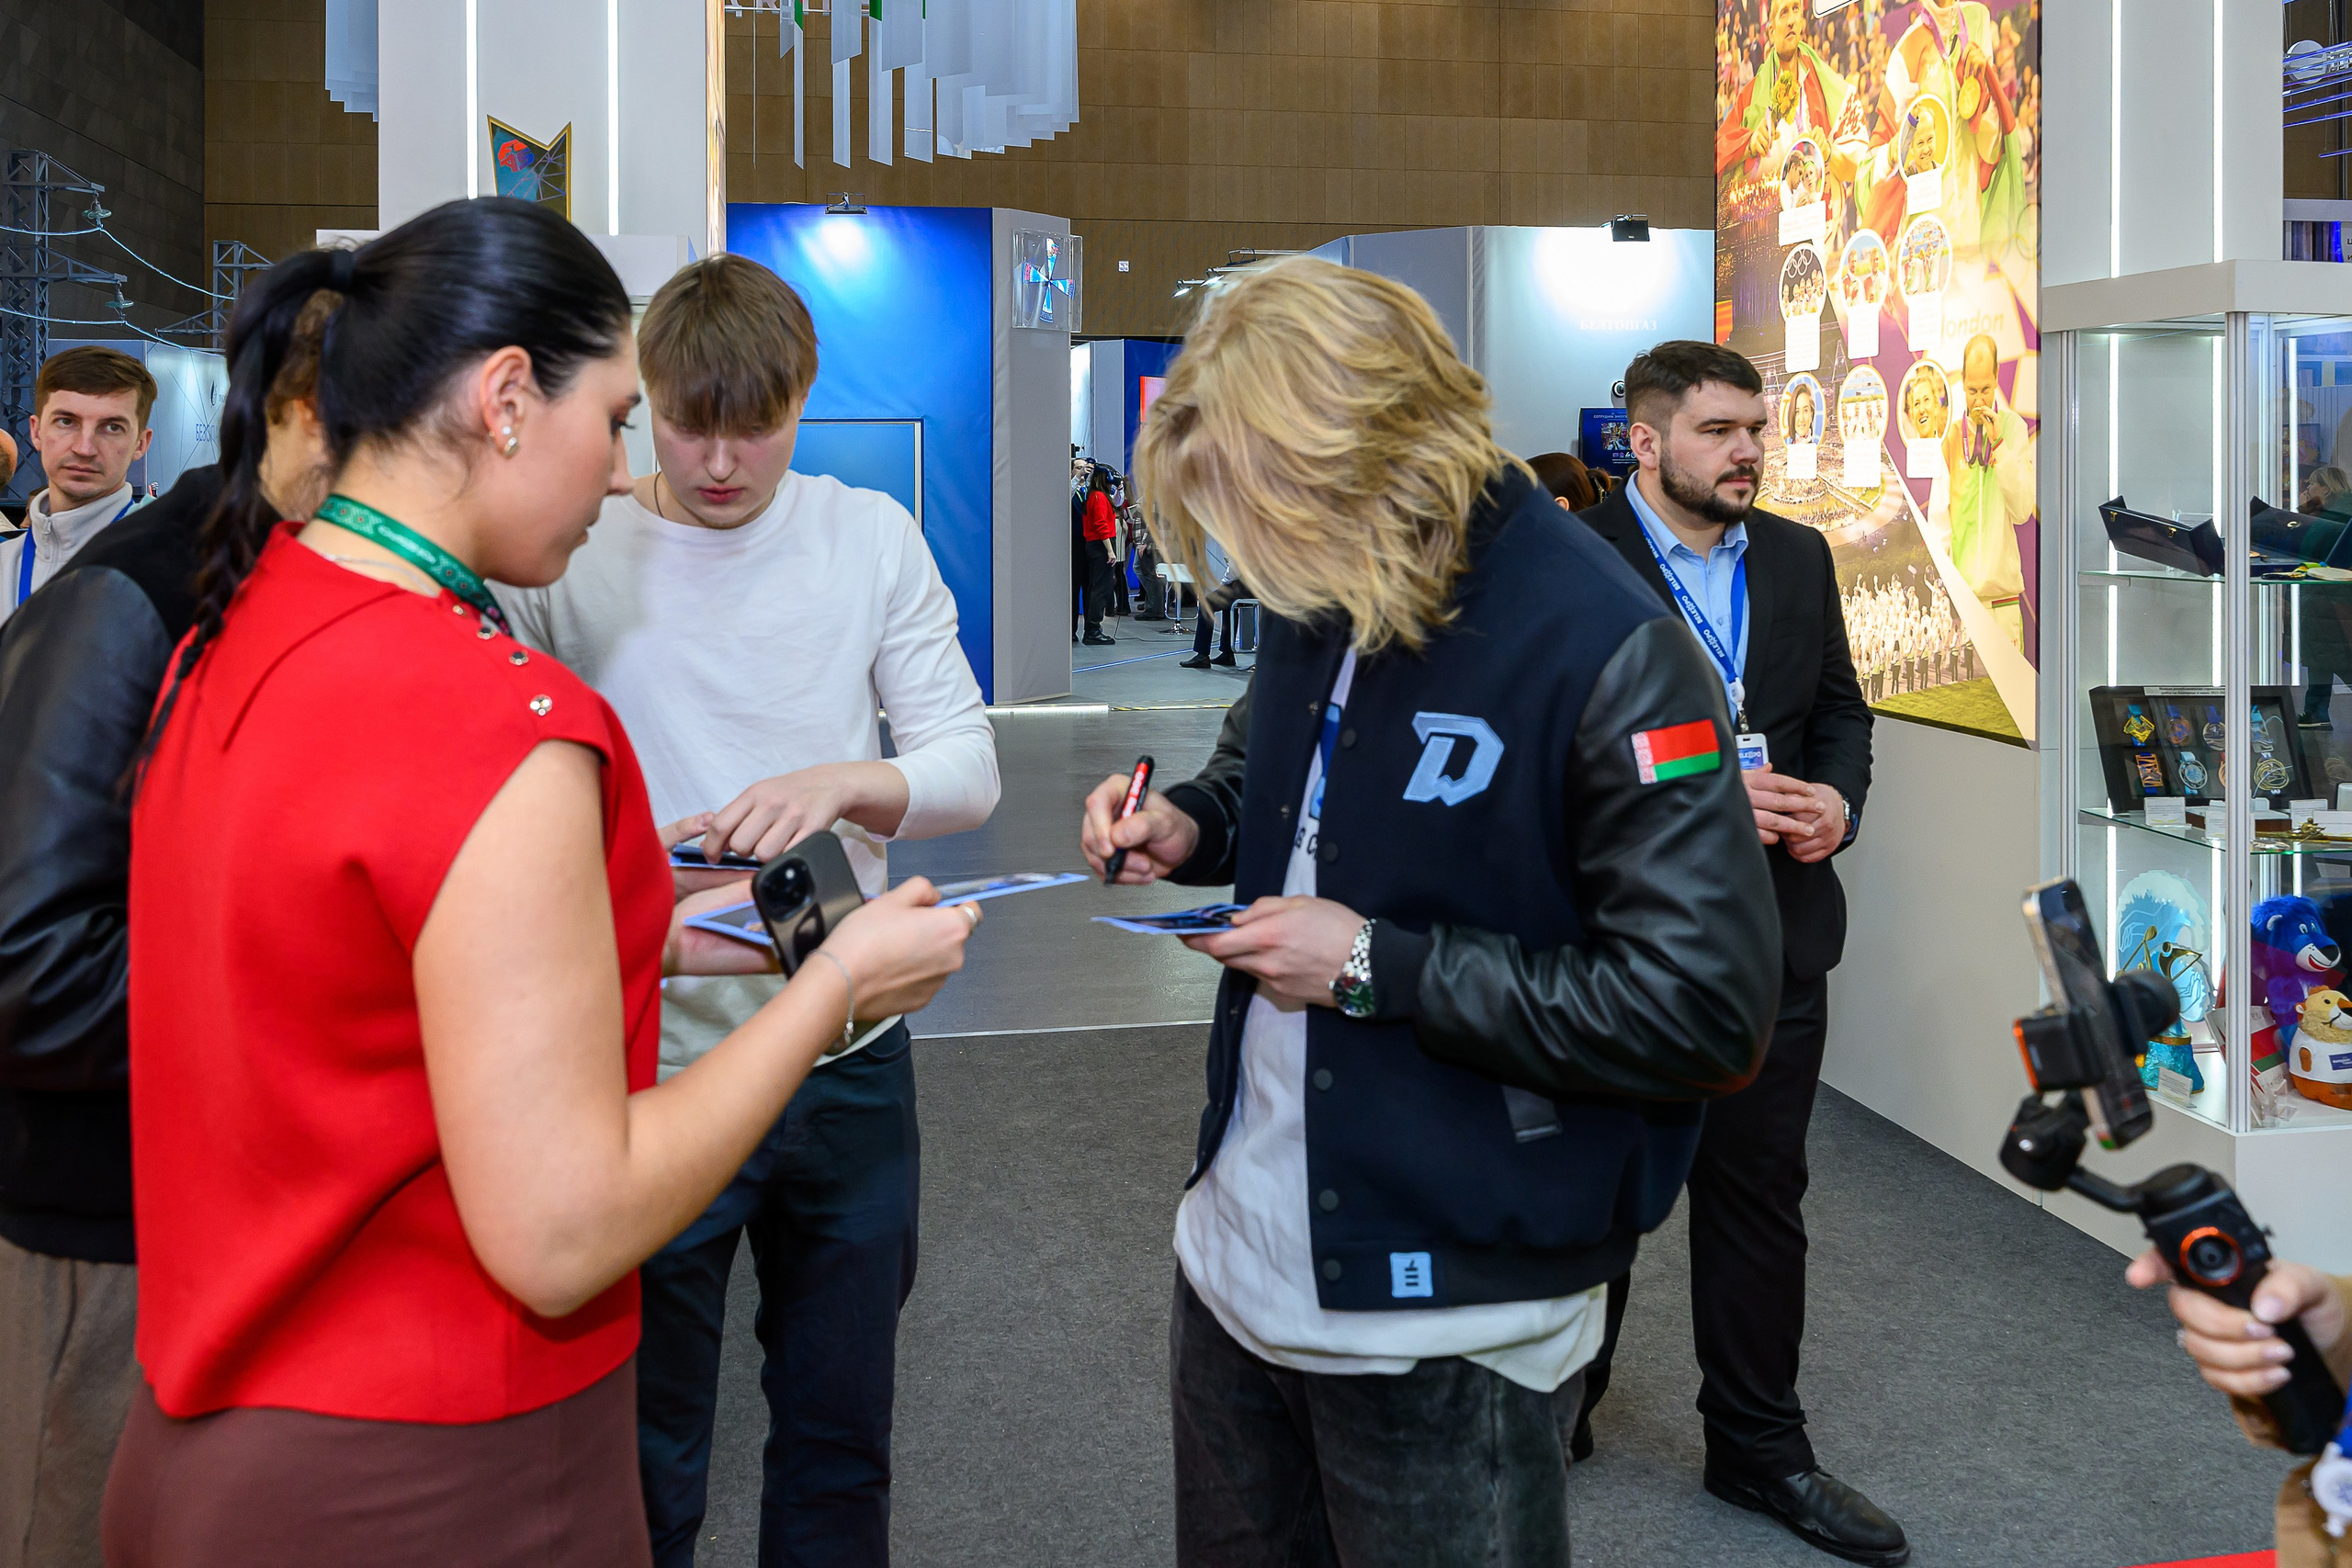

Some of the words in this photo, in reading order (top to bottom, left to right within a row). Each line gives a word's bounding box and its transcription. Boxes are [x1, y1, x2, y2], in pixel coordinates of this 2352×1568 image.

[1579, 319, 1657, 331] БЕЛТОПГАЗ
[1940, 309, 2004, 339] london
[1738, 751, 1762, 760] ELEXPO
